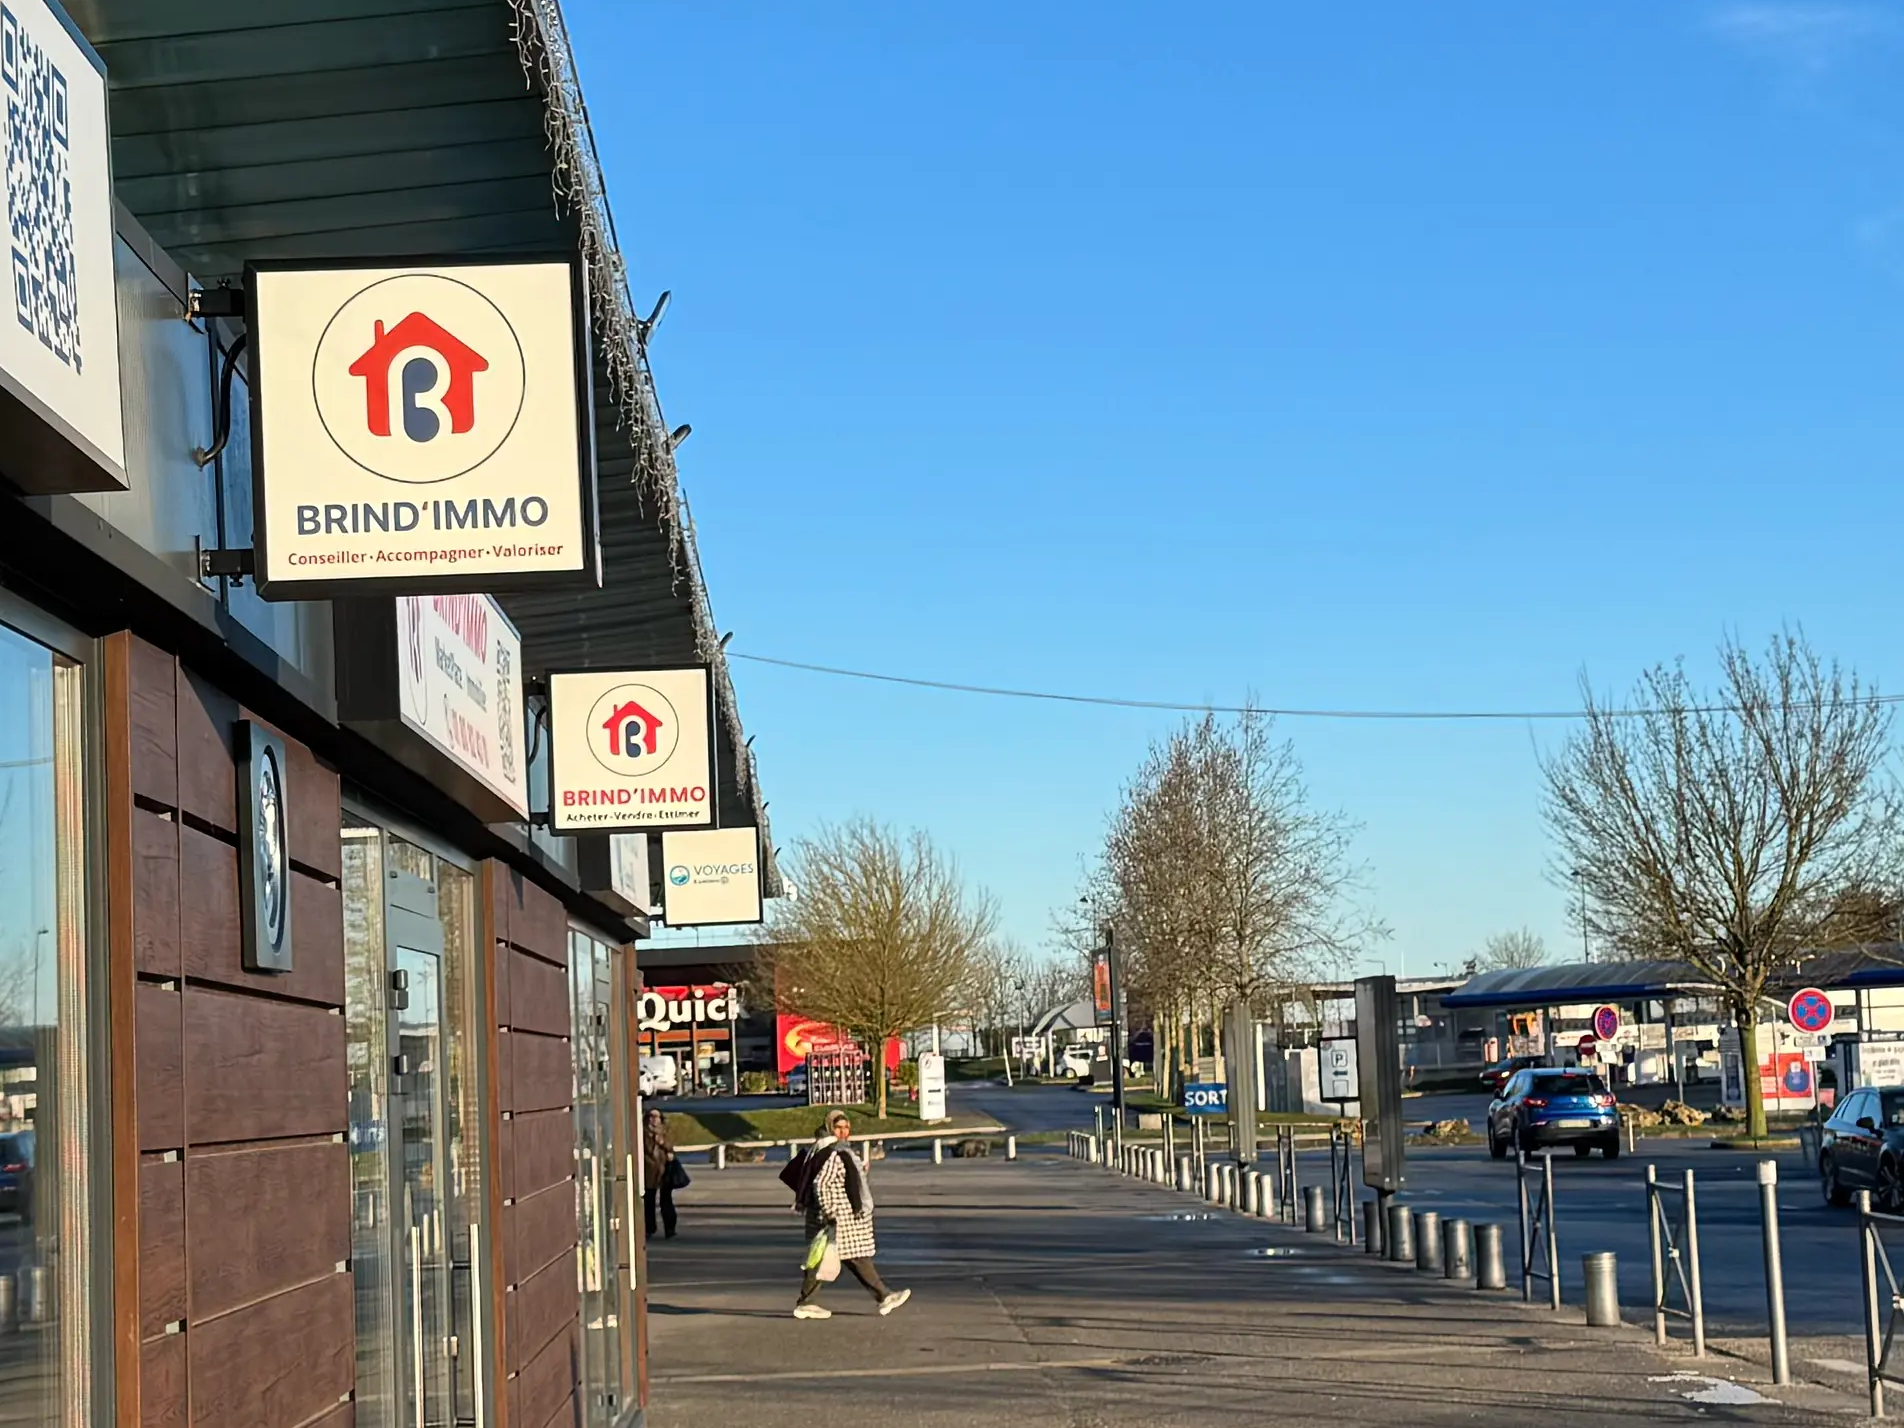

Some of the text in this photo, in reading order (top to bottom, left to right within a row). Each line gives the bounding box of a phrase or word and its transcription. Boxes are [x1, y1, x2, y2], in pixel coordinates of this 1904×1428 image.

[296, 495, 549, 536] BRIND'IMMO
[287, 543, 564, 566] Conseiller Accompagner Valoriser
[562, 786, 706, 807] BRIND'IMMO
[693, 862, 754, 876] VOYAGES
[1184, 1089, 1228, 1107] SORT
